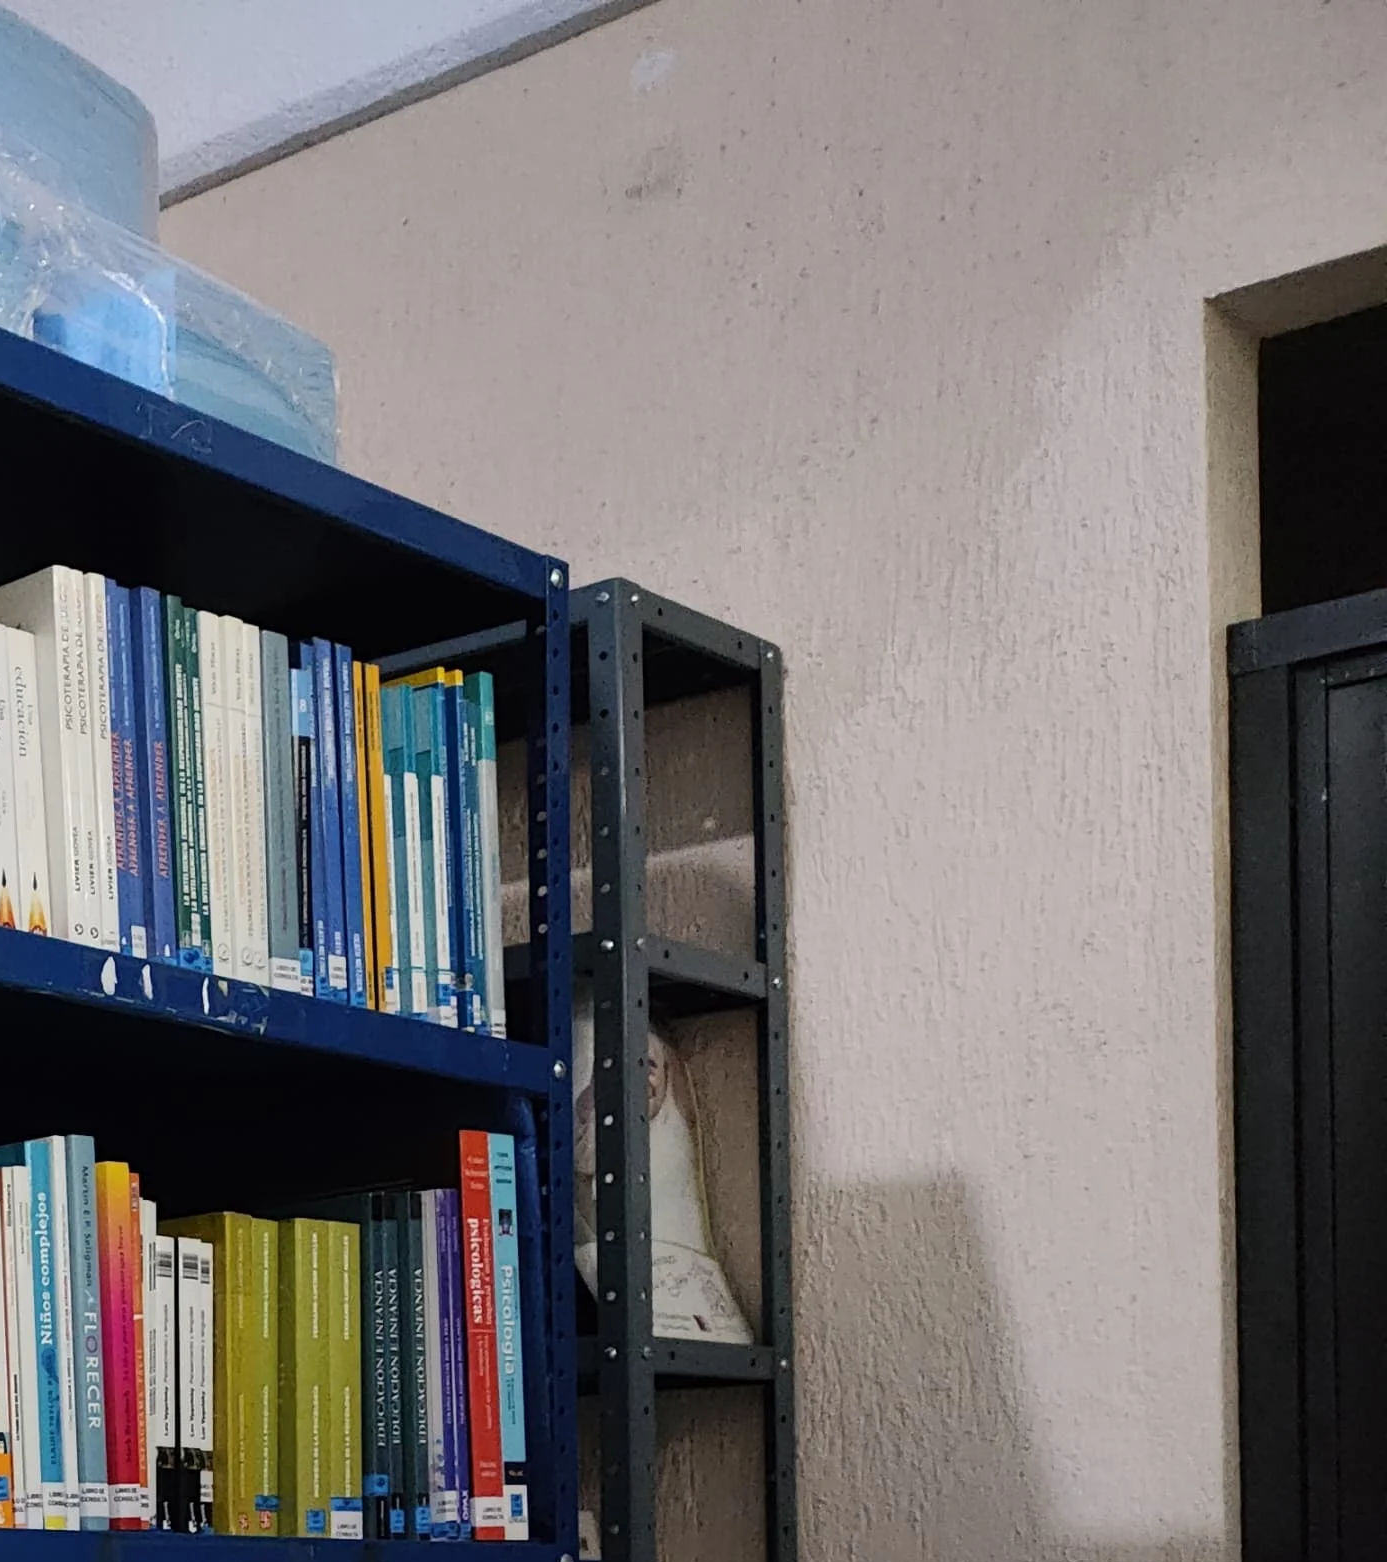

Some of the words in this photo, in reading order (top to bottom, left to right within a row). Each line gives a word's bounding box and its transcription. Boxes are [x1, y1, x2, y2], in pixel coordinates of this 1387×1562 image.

[34, 1192, 50, 1287] complejos
[39, 1292, 54, 1346] Niños
[84, 1311, 102, 1430] FLORECER
